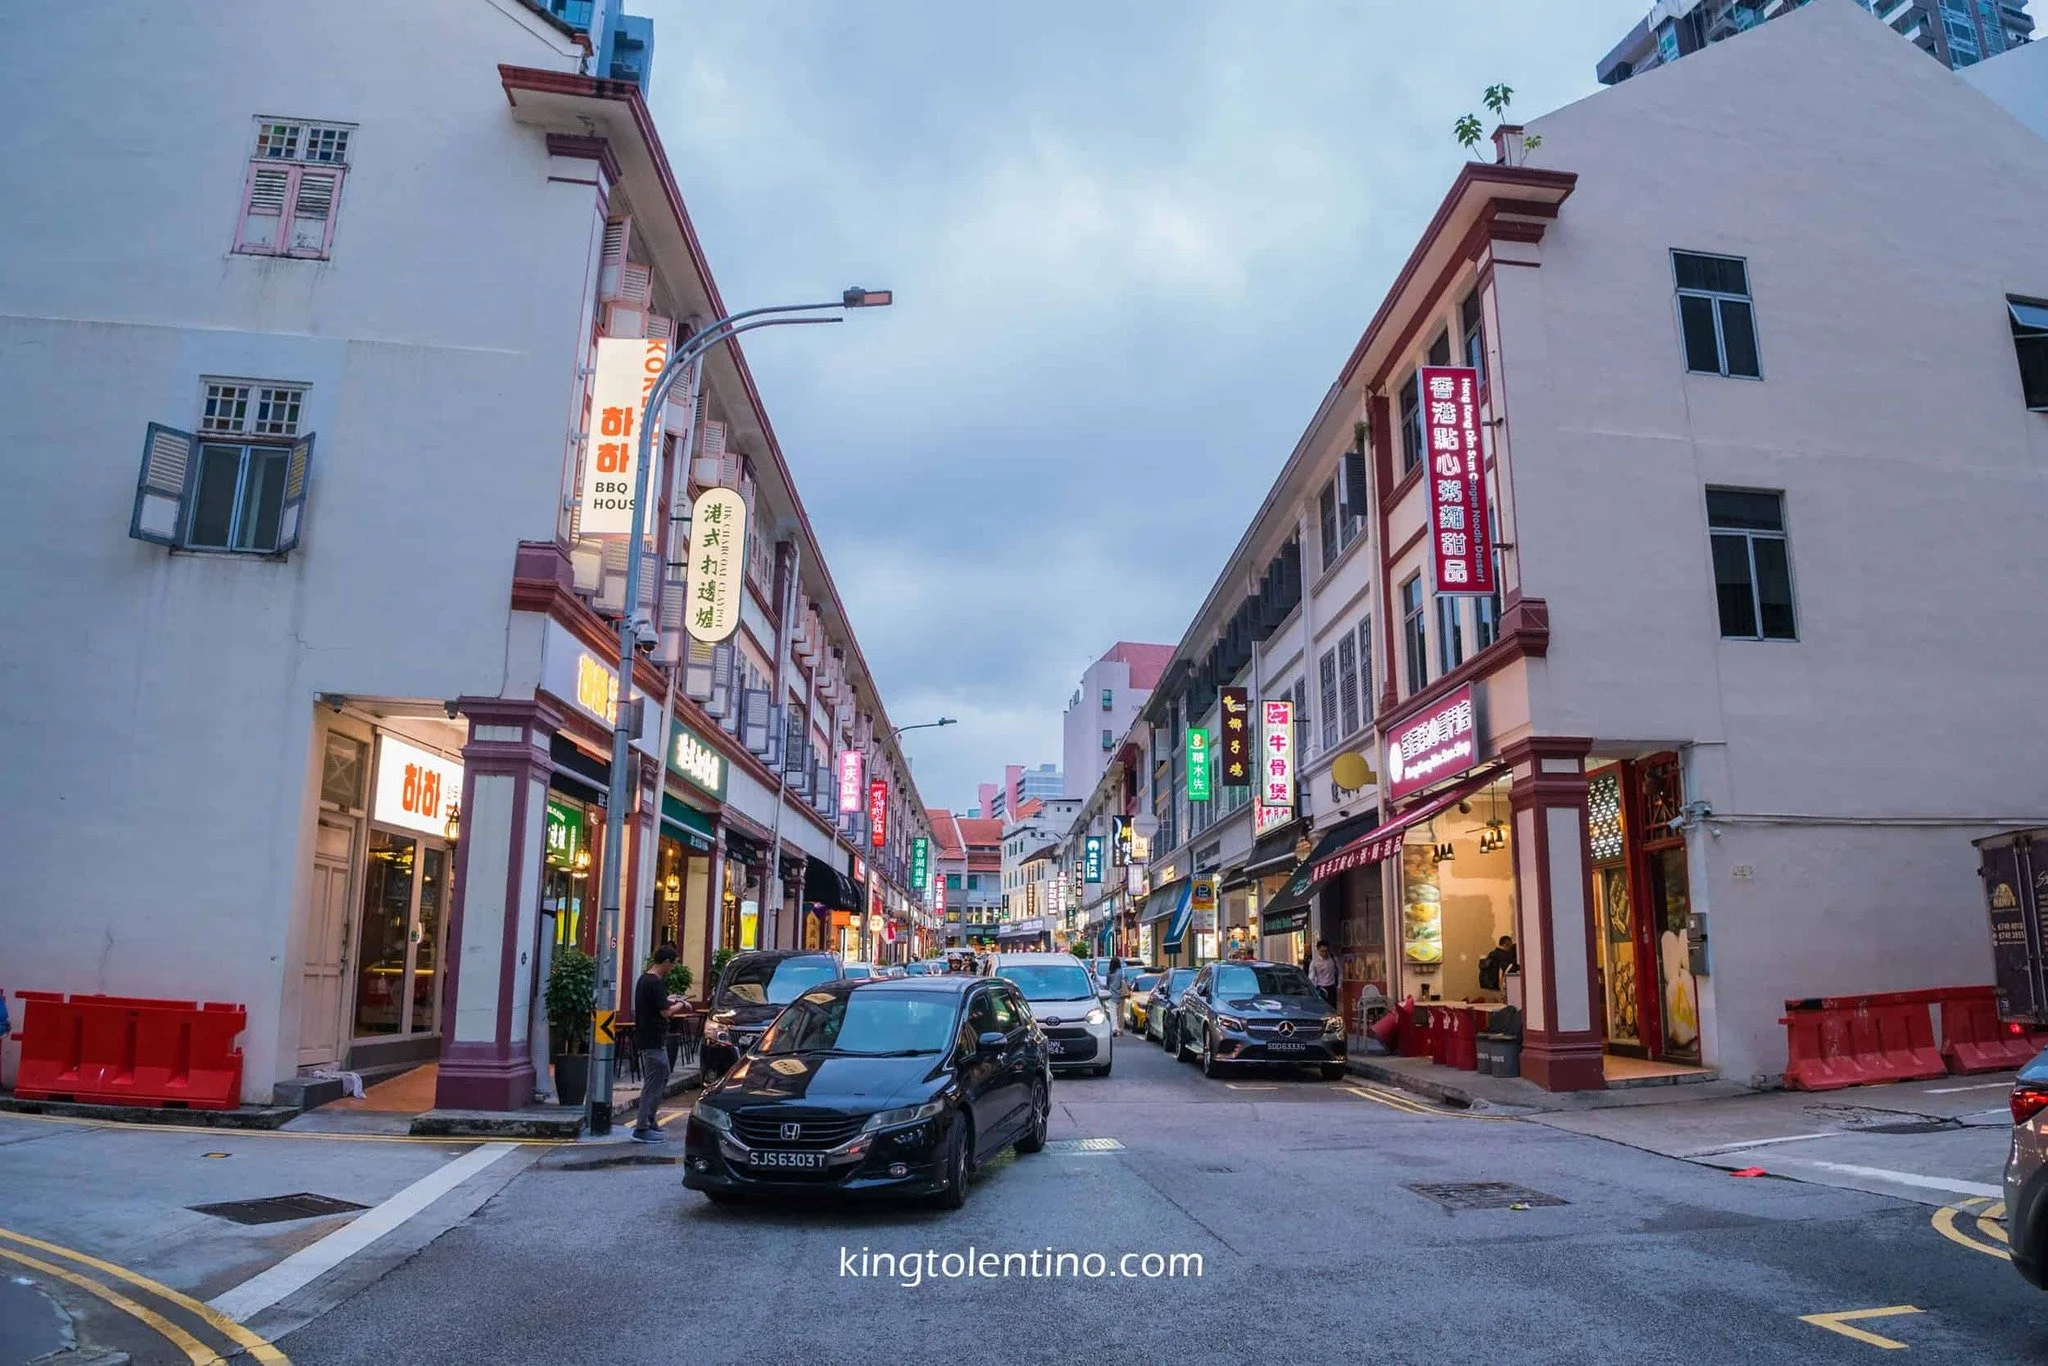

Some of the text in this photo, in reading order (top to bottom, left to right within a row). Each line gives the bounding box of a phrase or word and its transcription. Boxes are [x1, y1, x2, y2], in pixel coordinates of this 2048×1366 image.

[1461, 378, 1471, 403] Hong
[1463, 404, 1473, 428] Kong
[1465, 429, 1477, 448] Dim
[1467, 449, 1477, 471] Sum
[595, 482, 628, 494] BBQ
[594, 499, 636, 510] HOUS
[1269, 735, 1287, 800] 牛骨煲
[750, 1153, 825, 1167] SJS6303T
